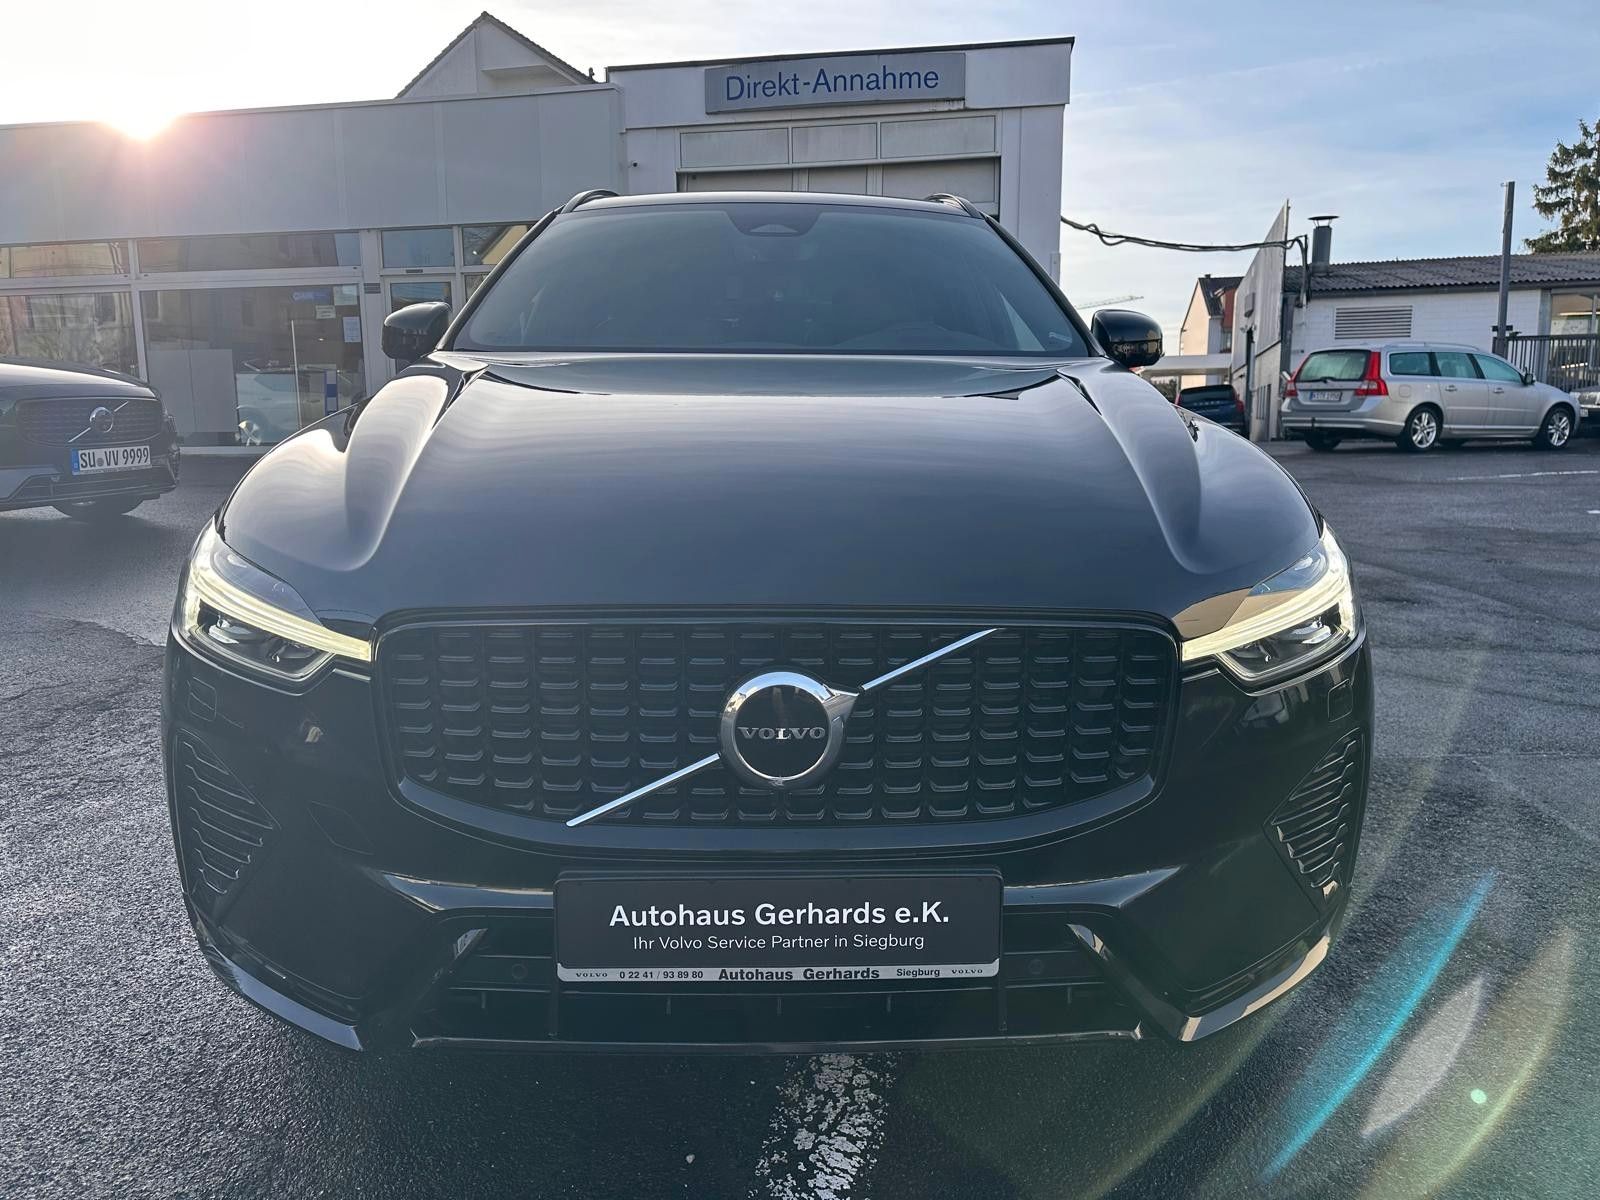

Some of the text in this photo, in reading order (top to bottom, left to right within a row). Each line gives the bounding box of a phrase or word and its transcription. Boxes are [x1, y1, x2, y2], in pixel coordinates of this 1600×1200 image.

[726, 65, 939, 101] Direkt-Annahme
[80, 447, 149, 468] SU VV 9999
[737, 726, 826, 740] VOLVO
[609, 901, 949, 927] Autohaus Gerhards e.K.
[633, 934, 924, 951] Ihr Volvo Service Partner in Siegburg
[619, 971, 626, 979] 0
[628, 971, 640, 979] 22
[642, 971, 654, 979] 41
[662, 971, 675, 979] 93
[677, 971, 689, 979] 89
[691, 971, 704, 979] 80
[718, 967, 880, 981] Autohaus Gerhards
[896, 967, 940, 977] Siegburg
